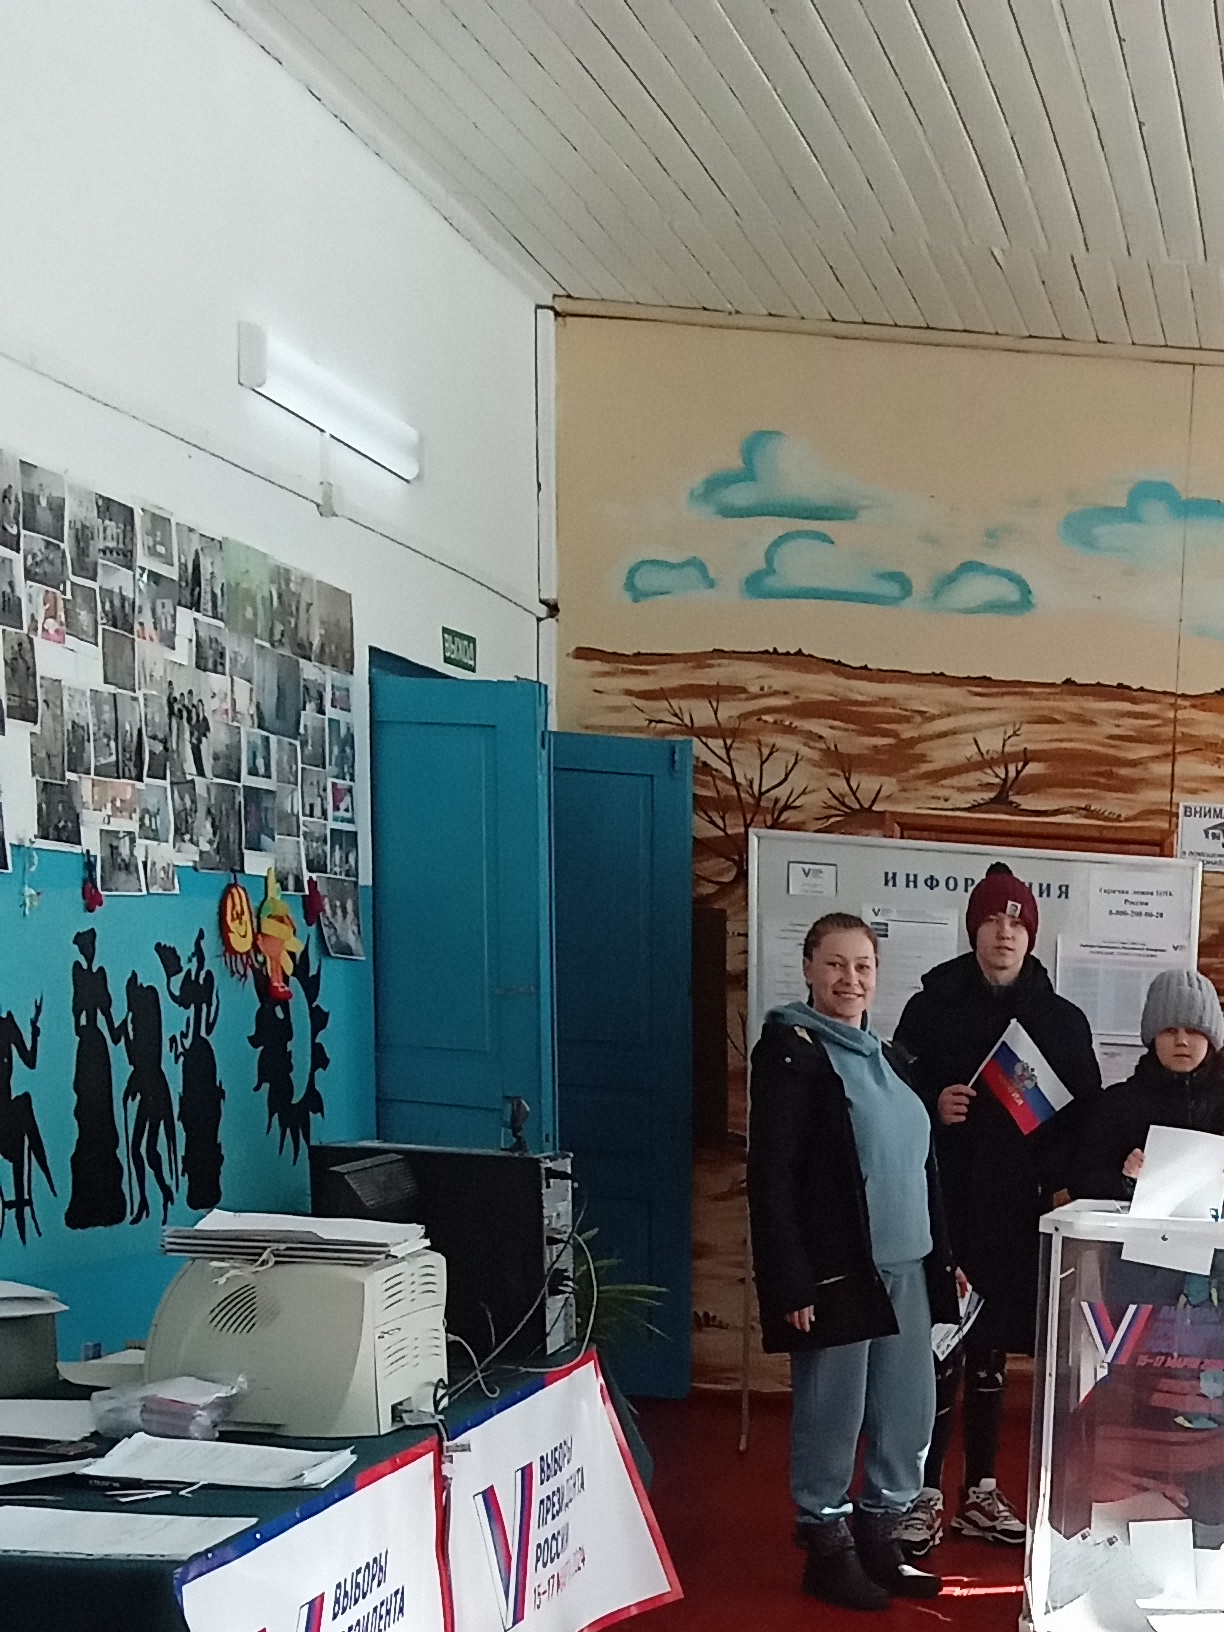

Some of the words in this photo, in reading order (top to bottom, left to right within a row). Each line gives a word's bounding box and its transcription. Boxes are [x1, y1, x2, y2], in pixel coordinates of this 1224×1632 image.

[443, 632, 475, 667] ВЫХОД
[884, 871, 1070, 900] ИНФОРИЯ
[331, 1546, 389, 1622] ВЫБОРЫ
